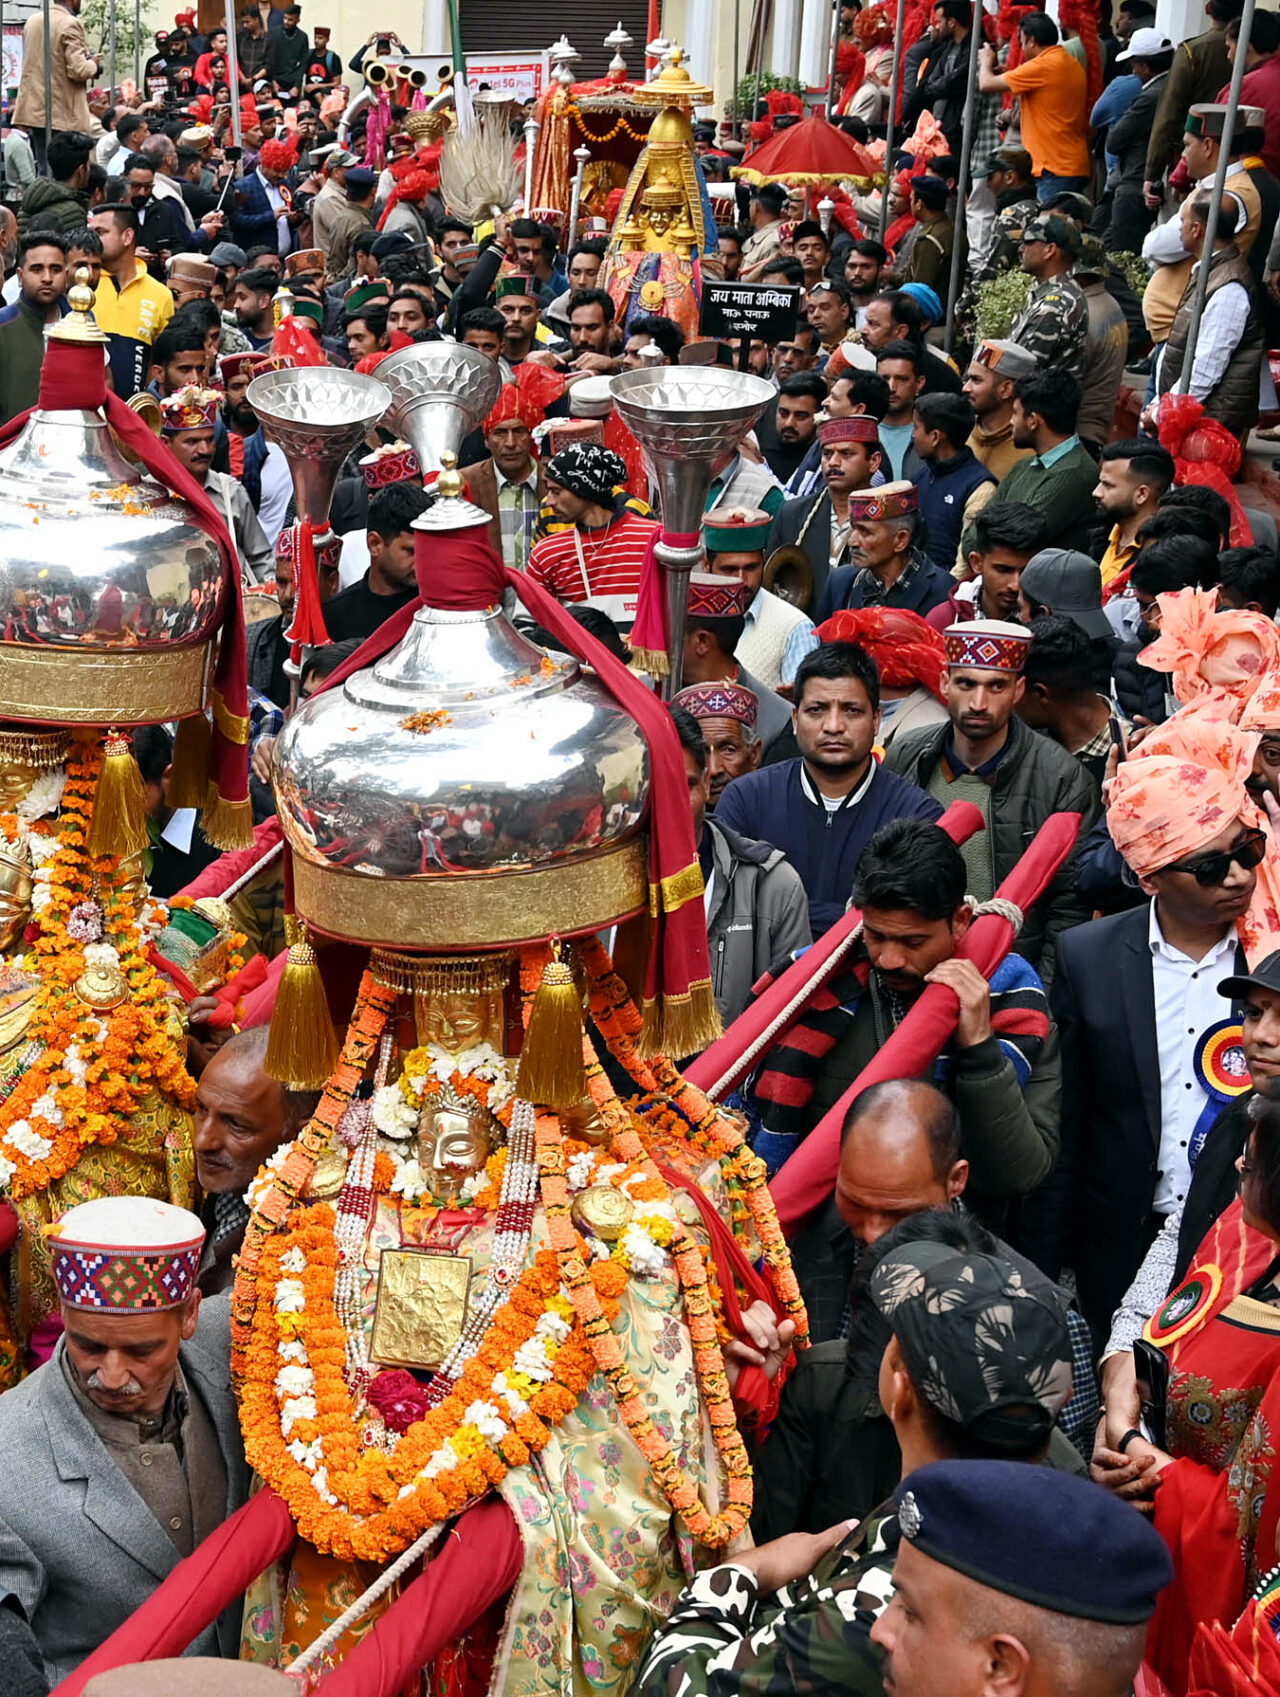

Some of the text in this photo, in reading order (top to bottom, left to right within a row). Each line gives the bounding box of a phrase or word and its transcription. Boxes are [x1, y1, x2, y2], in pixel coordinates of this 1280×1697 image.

[503, 79, 515, 88] 5G
[710, 290, 792, 307] जय माता अम्बिका
[137, 299, 155, 337] CAPE
